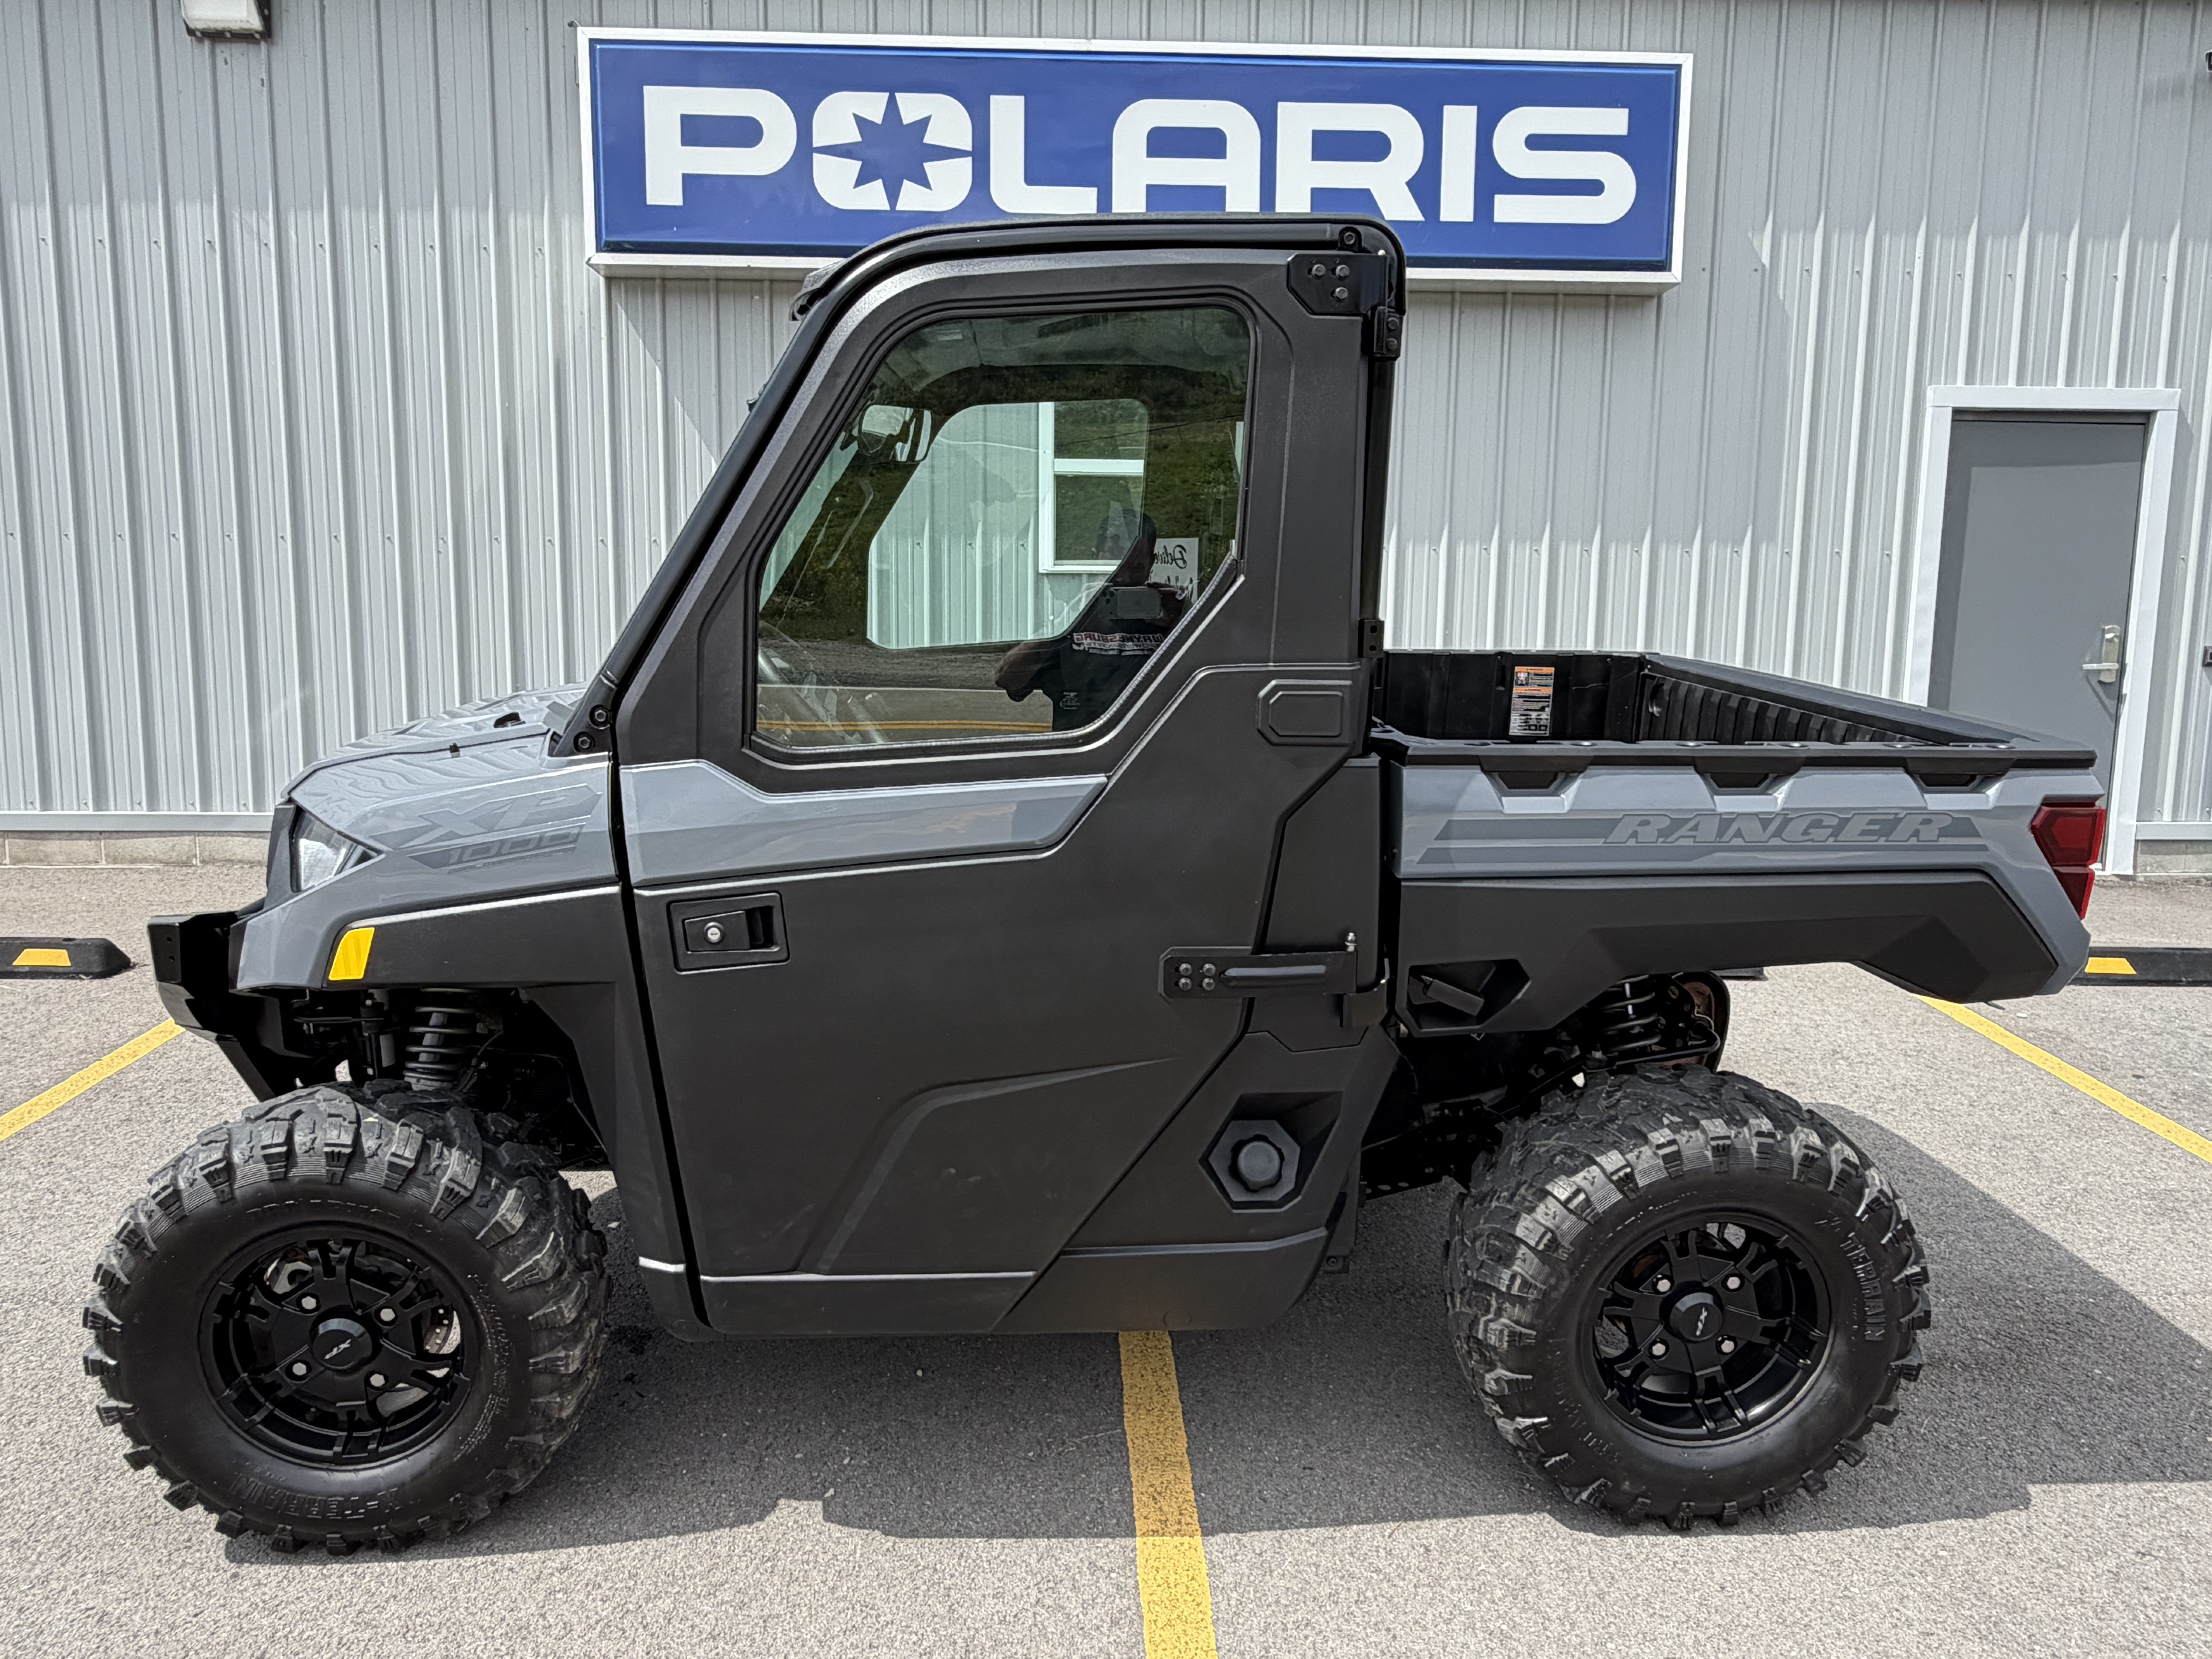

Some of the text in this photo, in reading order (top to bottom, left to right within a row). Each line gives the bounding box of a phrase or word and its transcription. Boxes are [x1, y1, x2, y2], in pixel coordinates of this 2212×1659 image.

[643, 84, 1638, 224] POLARIS
[448, 826, 582, 864] 1000
[1602, 812, 1953, 843] RANGER
